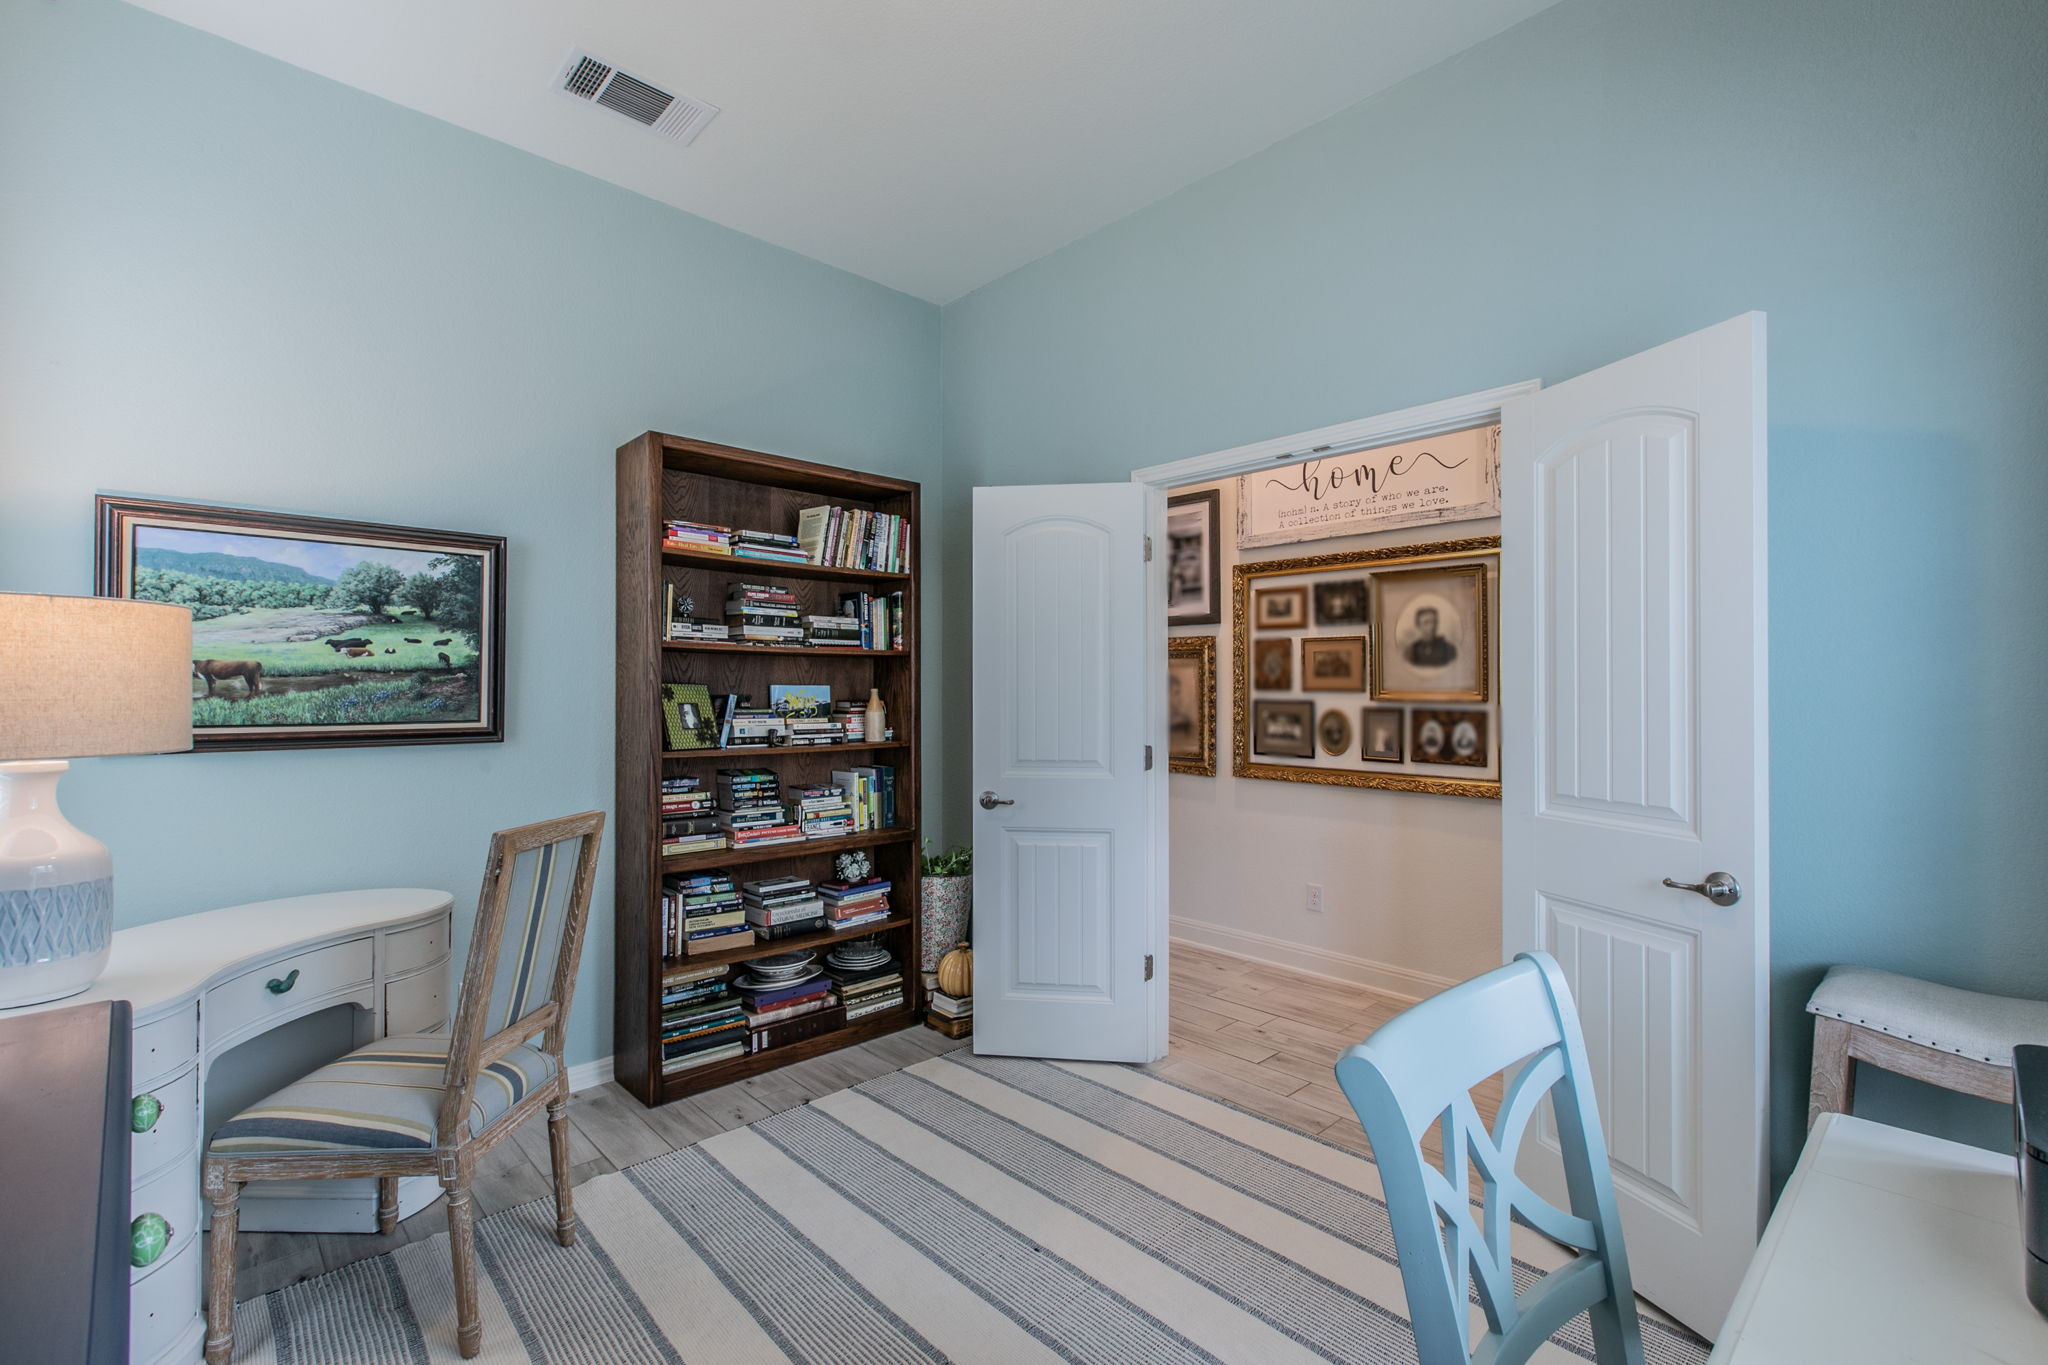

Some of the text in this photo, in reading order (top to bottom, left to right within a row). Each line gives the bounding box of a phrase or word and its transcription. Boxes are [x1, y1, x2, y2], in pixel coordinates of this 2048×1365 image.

[1323, 503, 1330, 511] A
[1333, 498, 1361, 509] story
[1365, 494, 1377, 504] of
[1381, 492, 1402, 501] who
[1406, 489, 1420, 497] we
[1424, 485, 1449, 495] are.
[1279, 497, 1449, 529] A collection of things we love.
